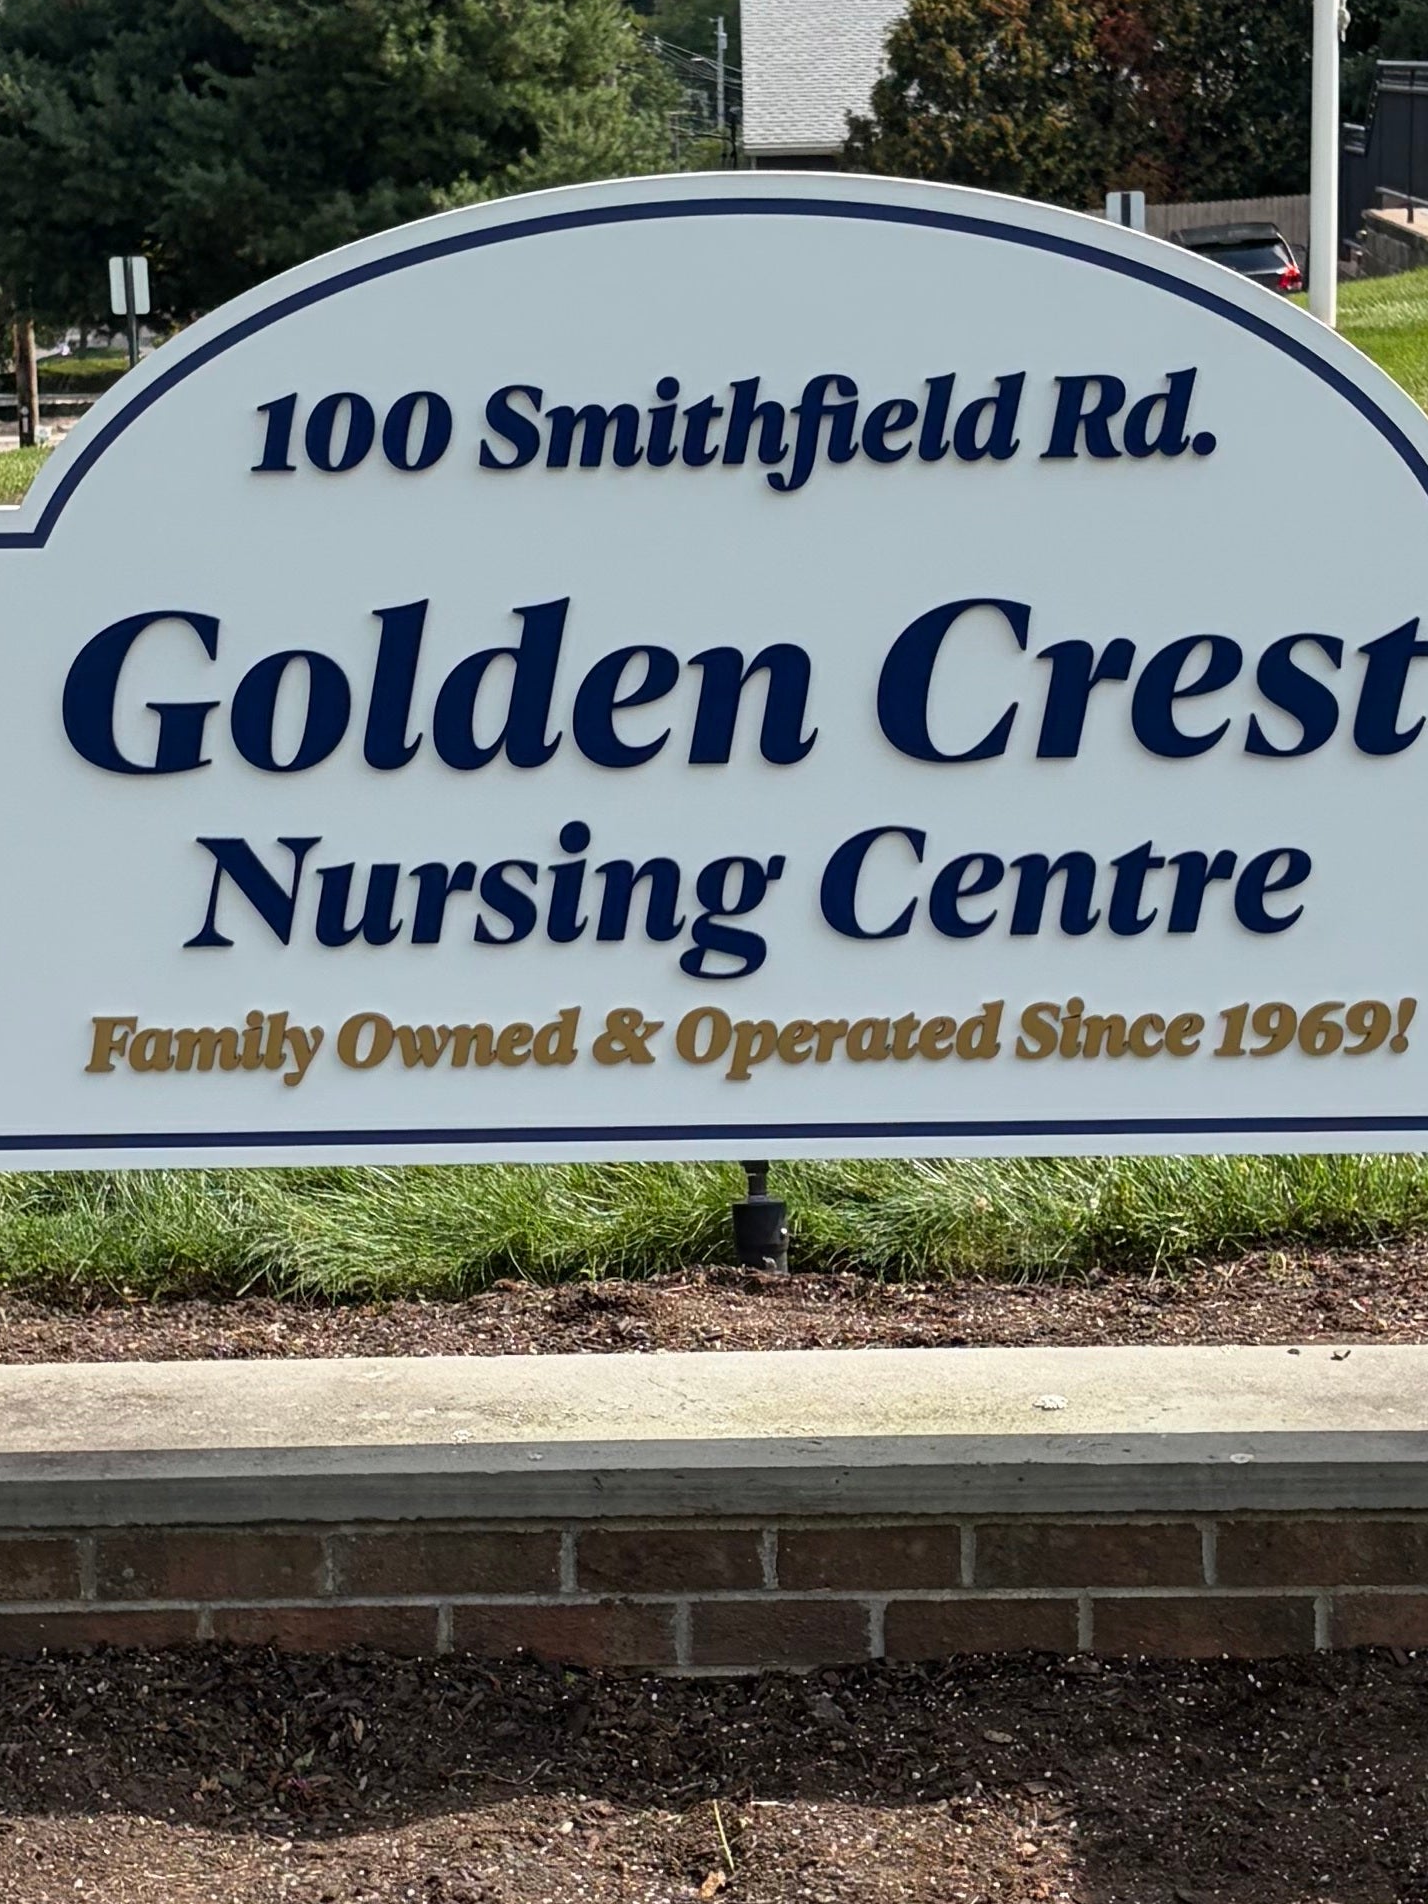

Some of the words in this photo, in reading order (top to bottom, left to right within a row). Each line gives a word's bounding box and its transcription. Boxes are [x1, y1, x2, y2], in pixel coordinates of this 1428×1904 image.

[250, 390, 453, 477] 100
[478, 371, 1027, 496] Smithfield
[1038, 366, 1217, 463] Rd.
[61, 596, 819, 778] Golden
[182, 820, 787, 983] Nursing
[819, 825, 1312, 942] Centre
[84, 1010, 324, 1088] Family
[337, 1006, 581, 1070] Owned
[592, 1007, 664, 1064] &
[675, 999, 1004, 1081] Operated
[1015, 997, 1205, 1061] Since
[1214, 997, 1417, 1057] 1969!
